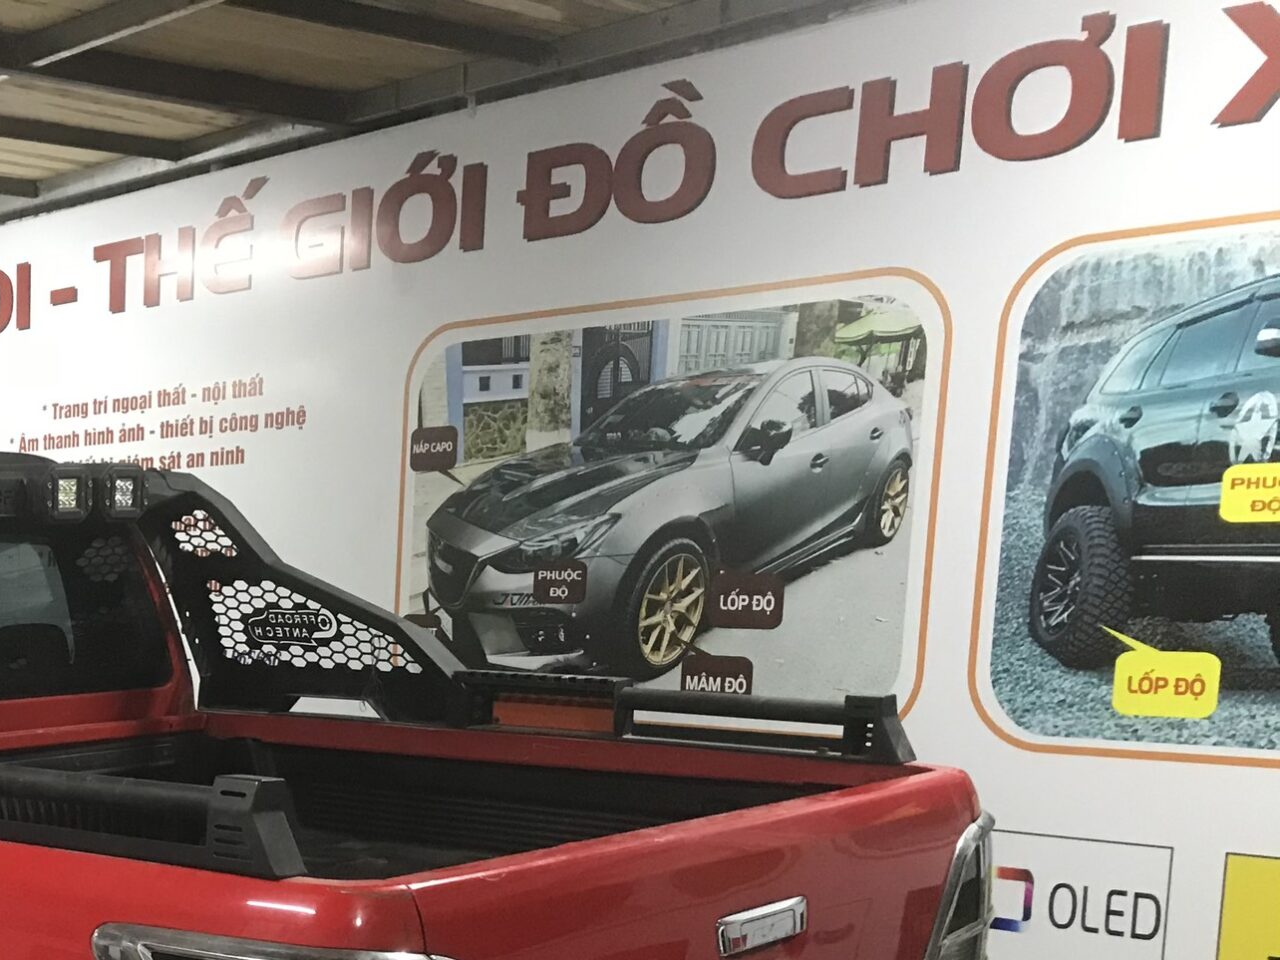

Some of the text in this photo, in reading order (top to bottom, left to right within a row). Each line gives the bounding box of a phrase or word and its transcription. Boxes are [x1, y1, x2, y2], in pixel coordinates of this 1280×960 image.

[93, 174, 270, 314] THẾ
[281, 148, 488, 280] GIỚI
[517, 78, 717, 242] ĐỒ
[751, 10, 1171, 200] CHƠI
[52, 402, 88, 420] Trang
[93, 396, 108, 415] trí
[113, 391, 152, 414] ngoại
[157, 383, 186, 408] thất
[202, 381, 226, 403] nội
[231, 373, 264, 400] thất
[43, 432, 80, 451] thanh
[84, 426, 114, 447] hình
[118, 422, 145, 443] ảnh
[160, 413, 194, 439] thiết
[199, 416, 214, 438] bị
[219, 410, 259, 432] công
[264, 405, 306, 430] nghệ
[159, 451, 181, 470] sát
[186, 452, 205, 467] an
[210, 446, 245, 466] ninh
[431, 441, 453, 453] CAPO
[537, 567, 583, 582] PHUỘC
[549, 584, 569, 599] ĐỘ
[720, 588, 775, 615] LỐP ĐỘ
[685, 672, 721, 692] MÂM
[1127, 669, 1206, 700] LỐP ĐỘ
[1048, 882, 1161, 941] OLED
